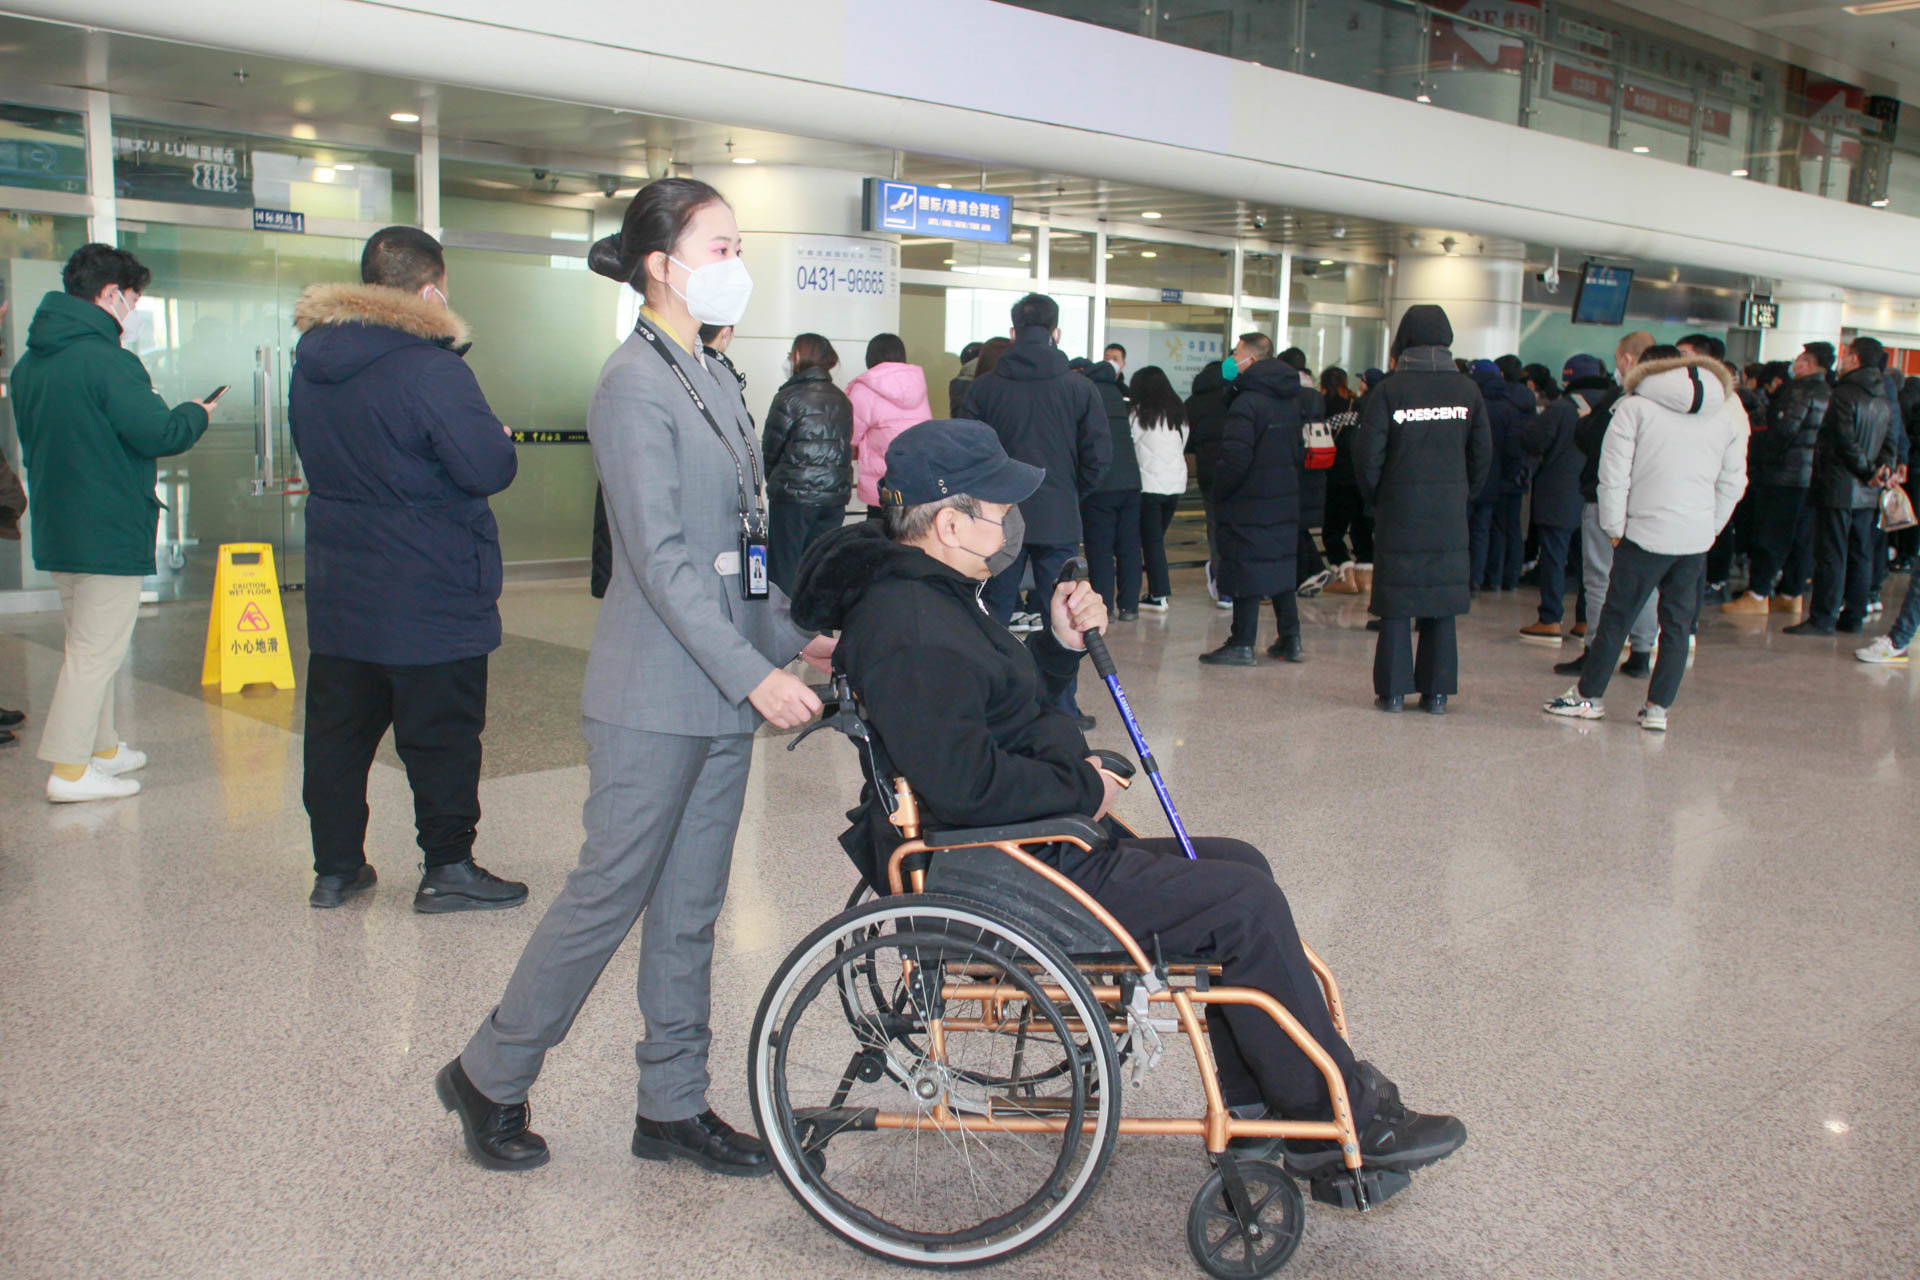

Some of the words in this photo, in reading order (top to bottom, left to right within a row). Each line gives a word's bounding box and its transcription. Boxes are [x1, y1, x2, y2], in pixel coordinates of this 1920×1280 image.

[296, 214, 302, 232] 1
[797, 265, 884, 295] 0431-96665
[1406, 406, 1469, 422] DESCENTE
[231, 638, 278, 655] 小心地滑
